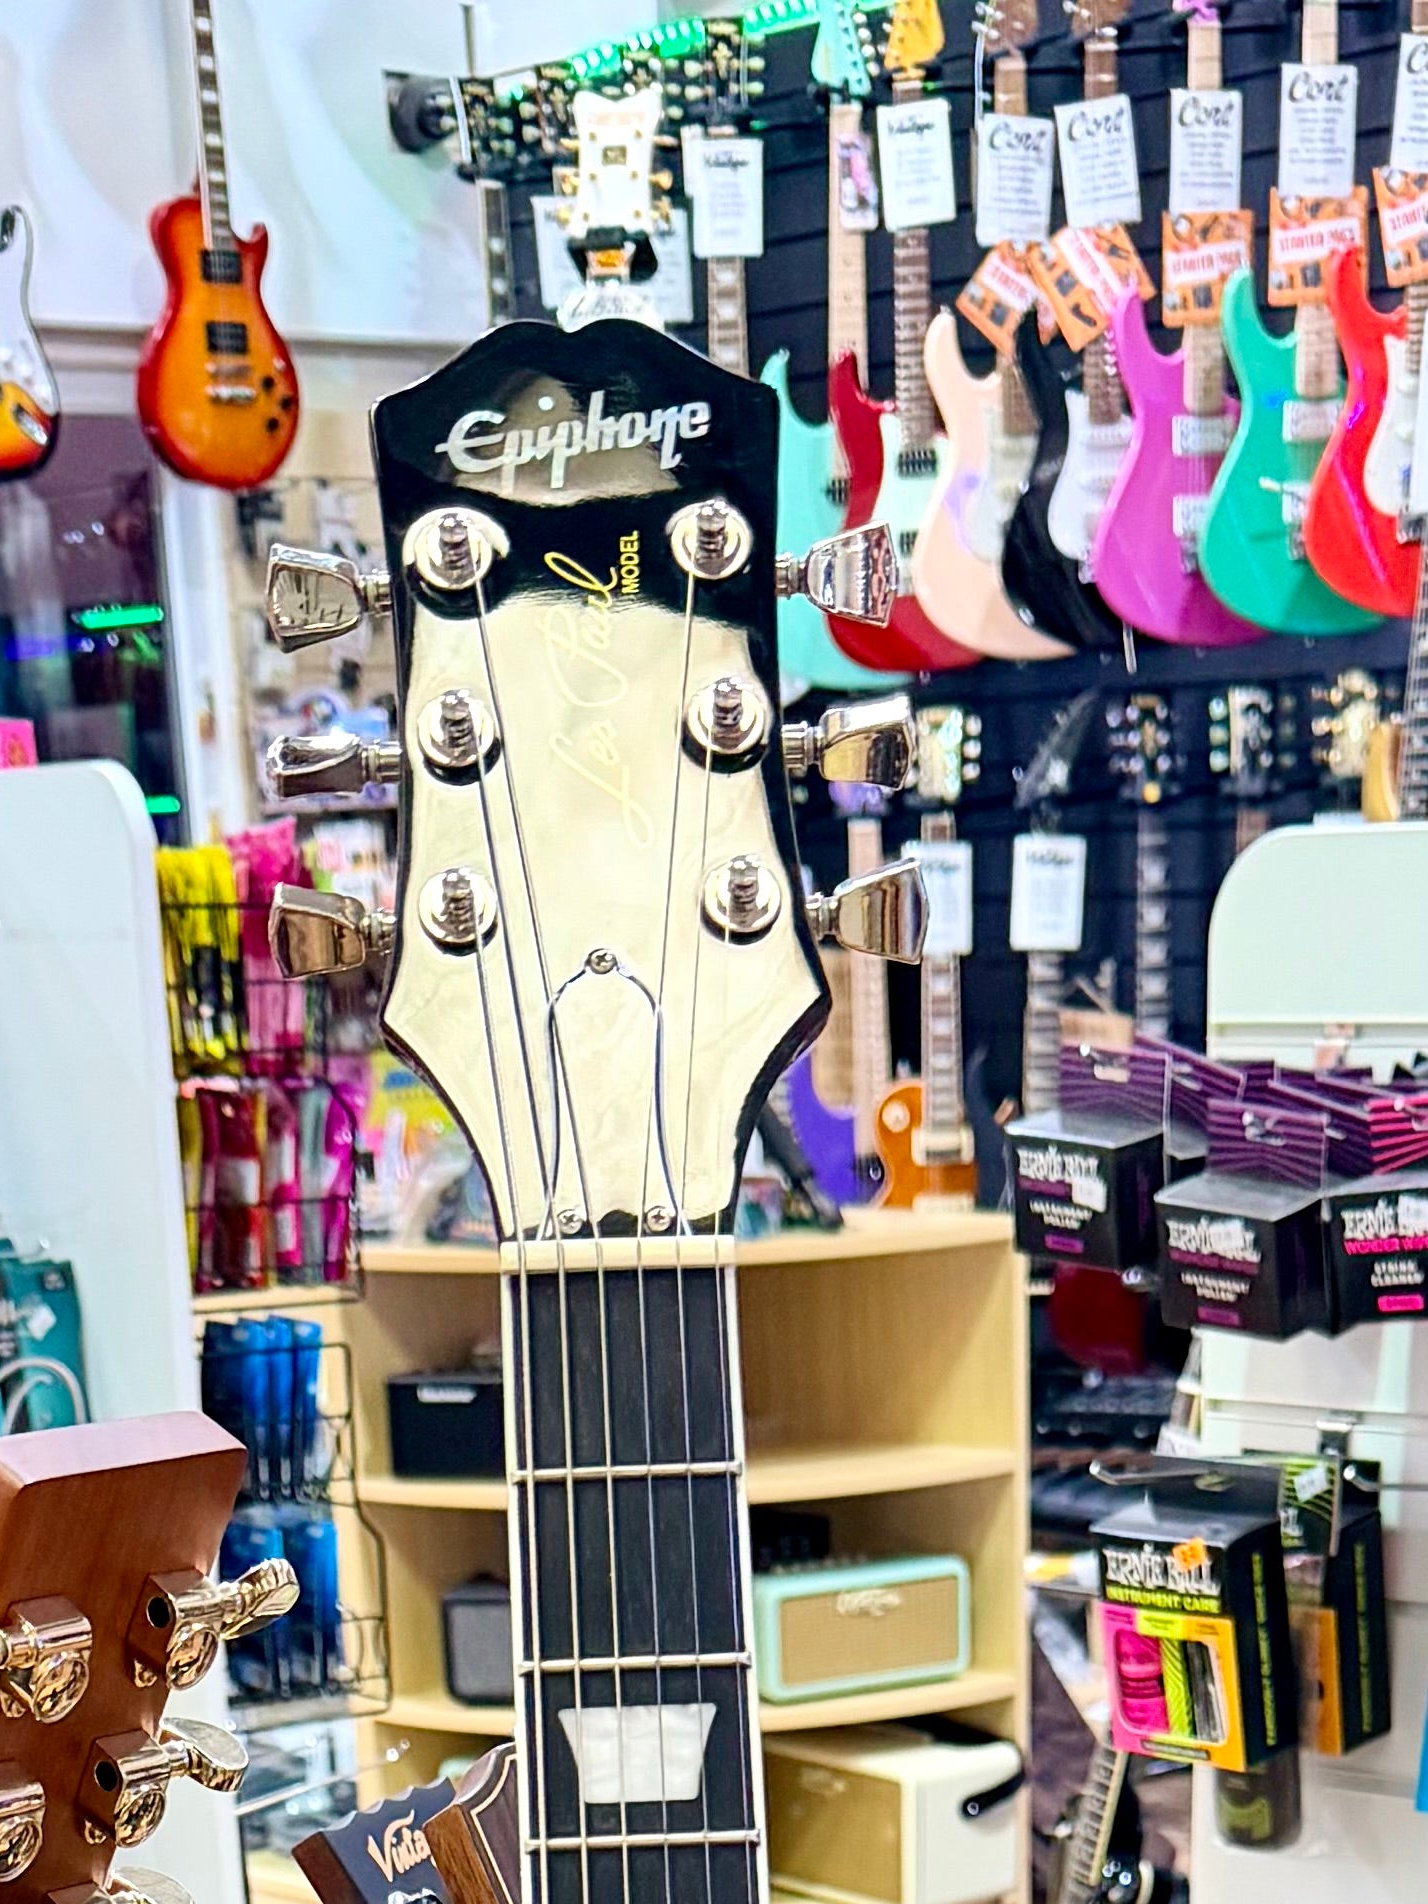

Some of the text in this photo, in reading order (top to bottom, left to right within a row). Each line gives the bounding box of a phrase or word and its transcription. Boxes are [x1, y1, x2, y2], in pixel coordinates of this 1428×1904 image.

[1288, 70, 1351, 103] Cort
[1067, 105, 1126, 142] Cort
[1178, 97, 1232, 129] Cort
[435, 389, 712, 495] Epiphone
[620, 529, 640, 594] MODEL
[1341, 1198, 1398, 1239] ERNIE
[1343, 1237, 1400, 1256] WONDER
[1101, 1541, 1164, 1588] ERNIE
[1106, 1583, 1221, 1614] INSTRUMENT CARE
[367, 1808, 438, 1884] Vinta
